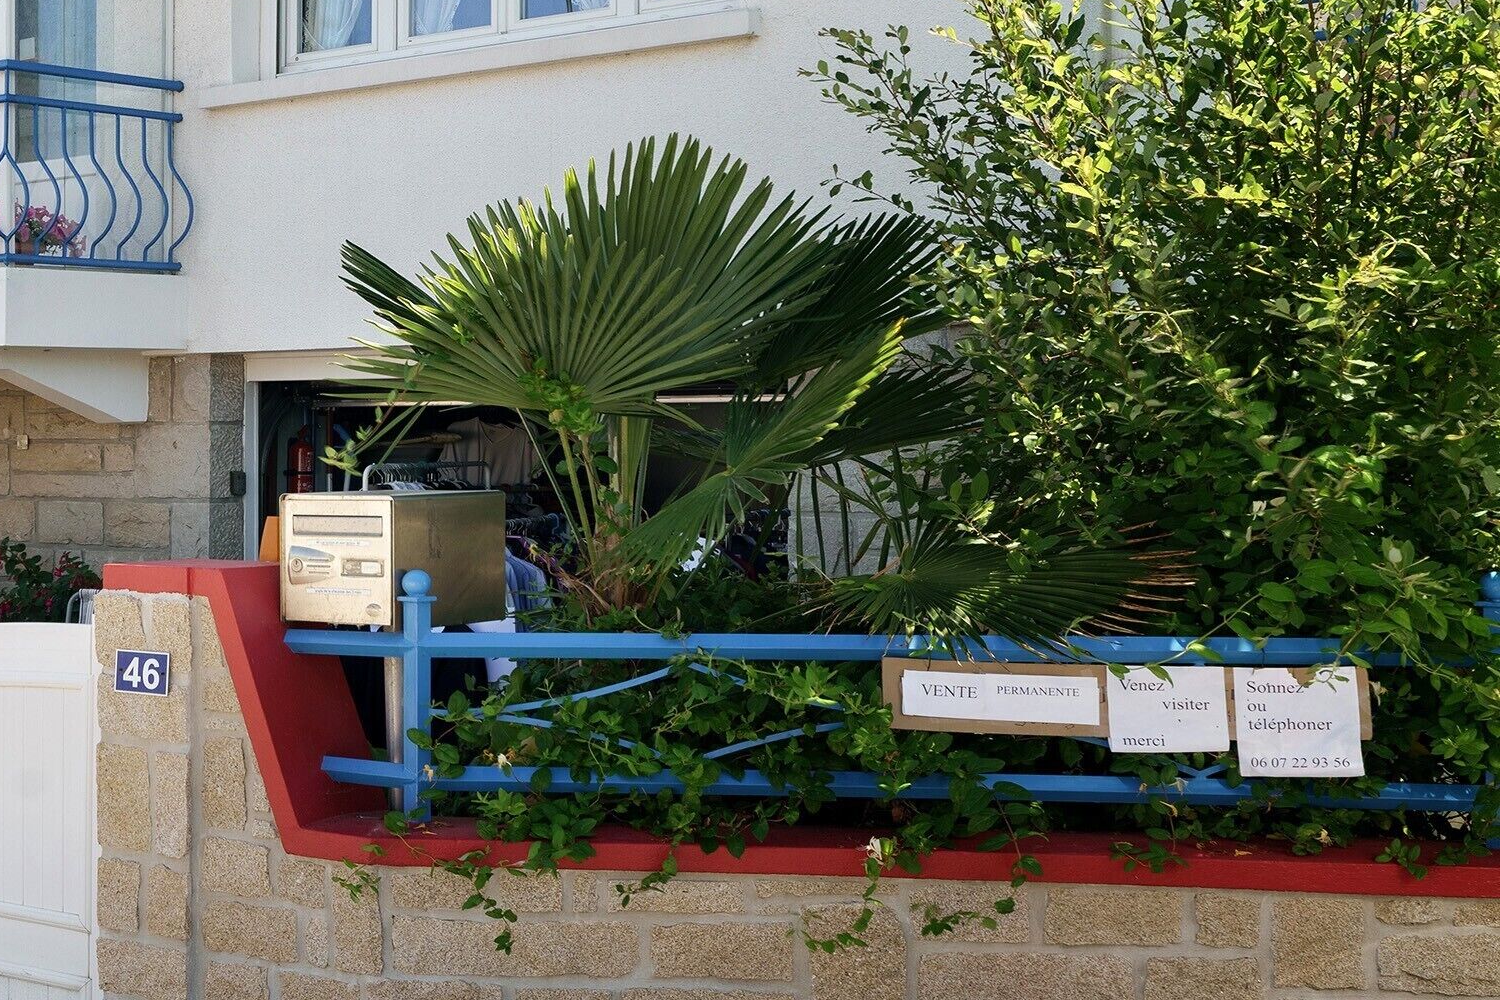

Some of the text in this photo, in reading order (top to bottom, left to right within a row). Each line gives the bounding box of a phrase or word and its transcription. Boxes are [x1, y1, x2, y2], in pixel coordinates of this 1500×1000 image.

[122, 656, 160, 690] 46
[921, 683, 1080, 699] VENTE PERMANENTE
[1120, 679, 1165, 691] Venez
[1246, 681, 1304, 694] Sonnez
[1162, 697, 1210, 710] visiter
[1247, 702, 1267, 712] ou
[1248, 718, 1333, 733] téléphoner
[1122, 734, 1165, 747] merci
[1250, 757, 1351, 768] 06 07 22 93 56
